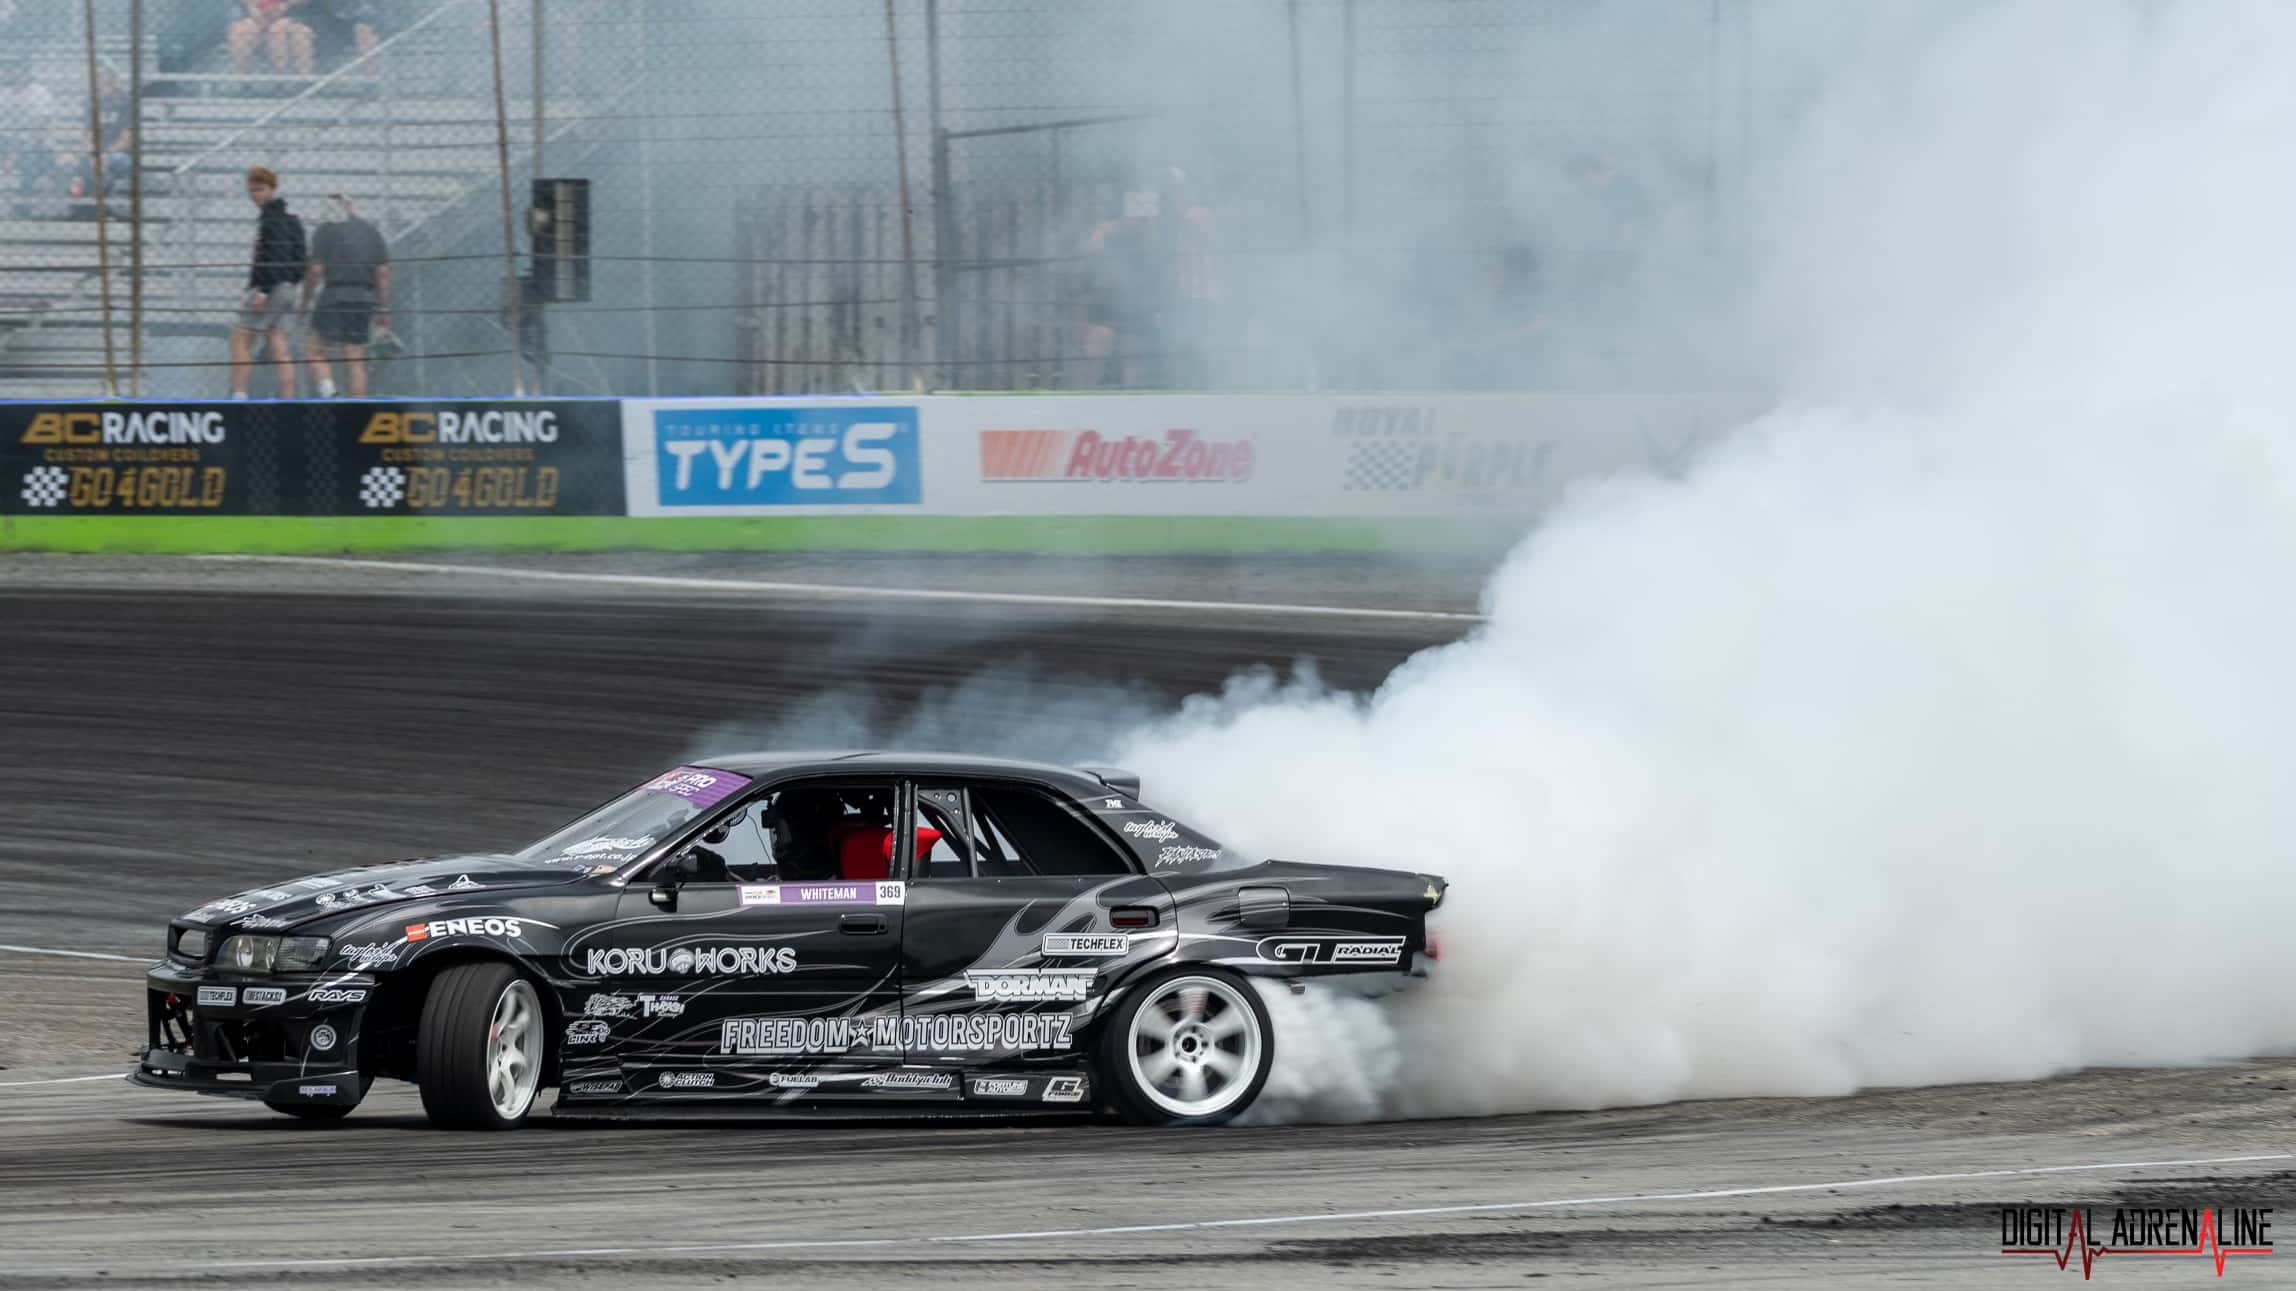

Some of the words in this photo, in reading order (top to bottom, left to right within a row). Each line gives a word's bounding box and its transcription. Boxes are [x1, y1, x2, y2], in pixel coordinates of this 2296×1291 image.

[1066, 429, 1253, 482] AutoZone
[800, 887, 857, 900] WHITEMAN
[879, 885, 901, 899] 369
[429, 919, 521, 937] ENEOS
[1070, 937, 1124, 950] TECHFLEX
[1334, 943, 1403, 959] RADIAL
[587, 948, 668, 975] KORU
[695, 947, 798, 974] WORKS
[972, 971, 1090, 1001] DORMAN
[307, 989, 367, 1002] RAYS
[721, 1018, 850, 1054] FREEDOM
[872, 1014, 1073, 1051] MOTORSPORTZ
